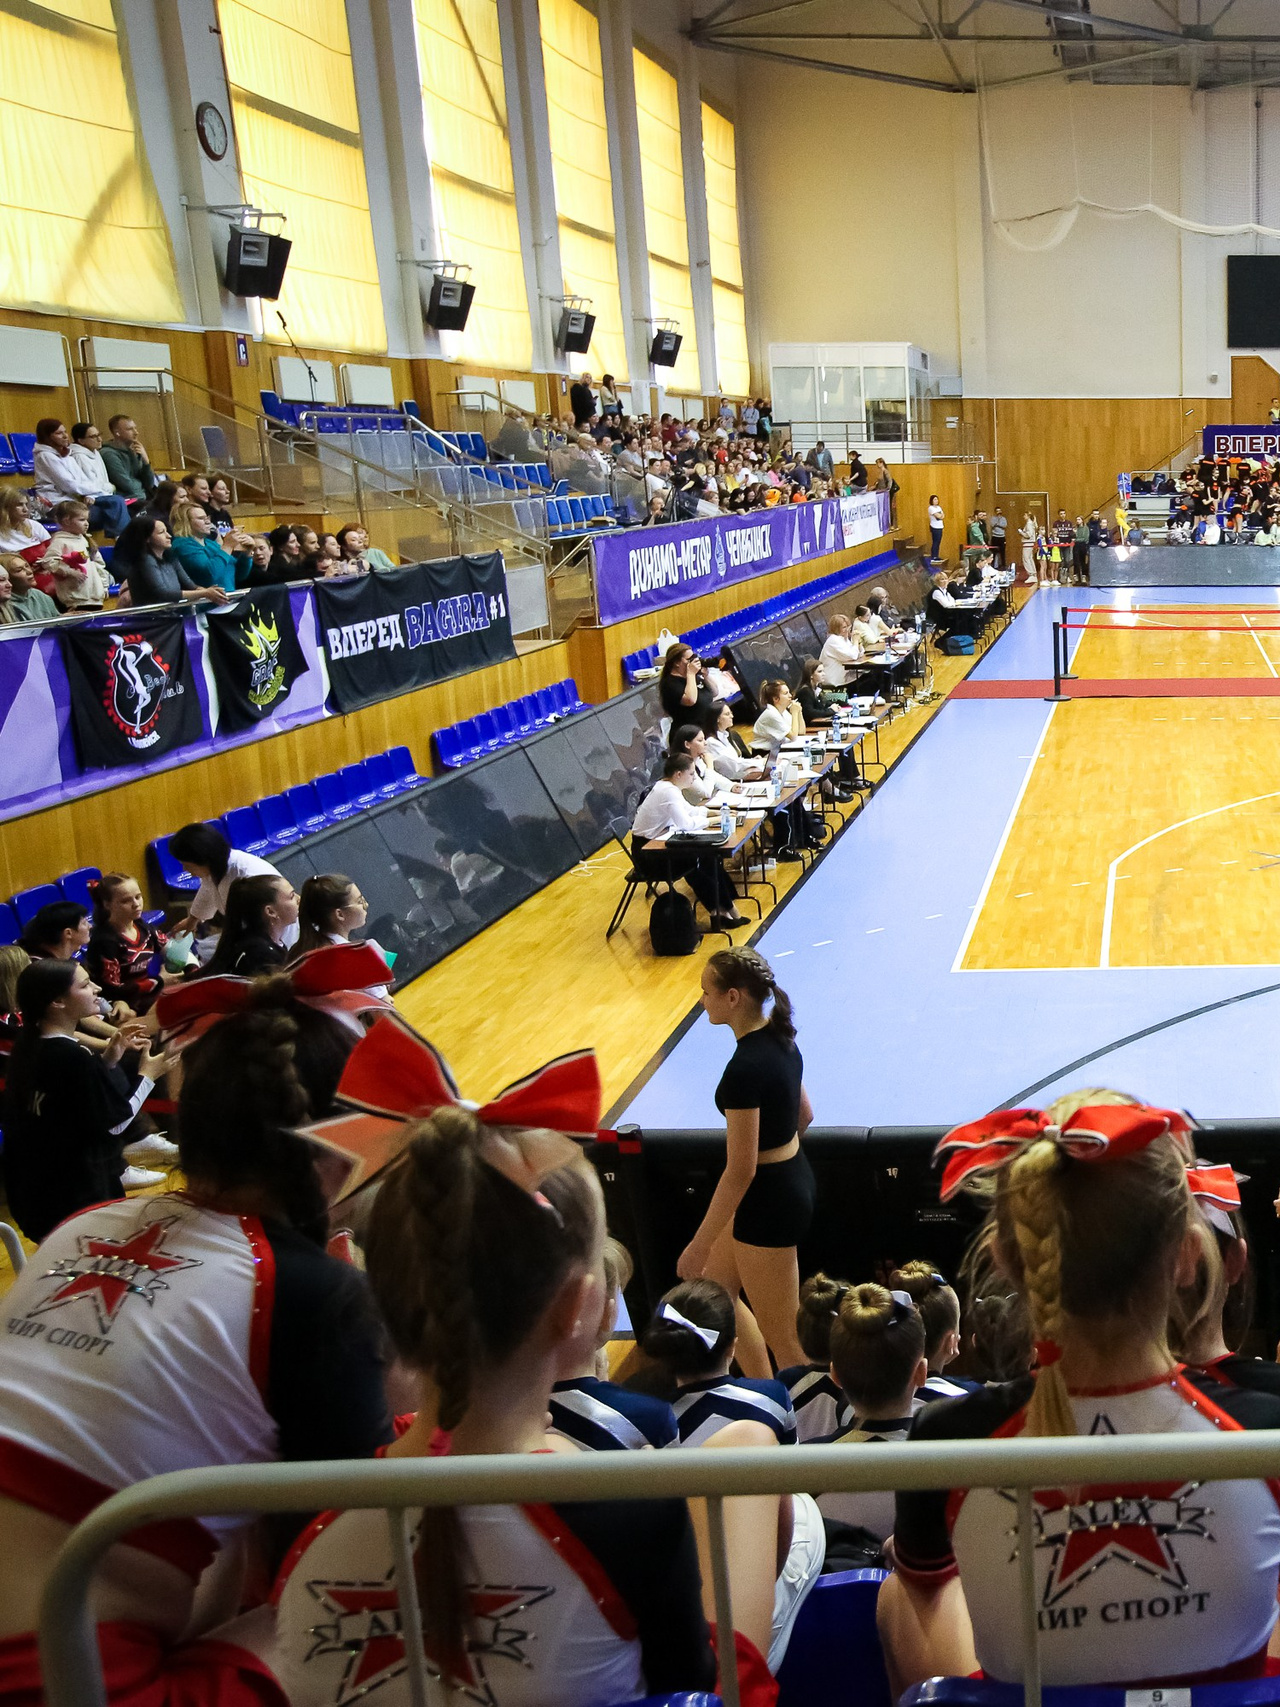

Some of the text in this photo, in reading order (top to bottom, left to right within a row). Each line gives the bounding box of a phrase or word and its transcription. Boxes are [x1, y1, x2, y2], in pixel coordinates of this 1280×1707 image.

[629, 523, 772, 600] ДИНАМО-МЕТАР ЧЕЛЯБИНСК
[327, 592, 506, 661] ВПЕРЕД BAGIRA #1
[90, 1256, 148, 1278] ALEX
[8, 1317, 115, 1356] ЧИР СПОРТ
[1068, 1499, 1157, 1527] ALEX
[1100, 1592, 1211, 1624] СПОРТ
